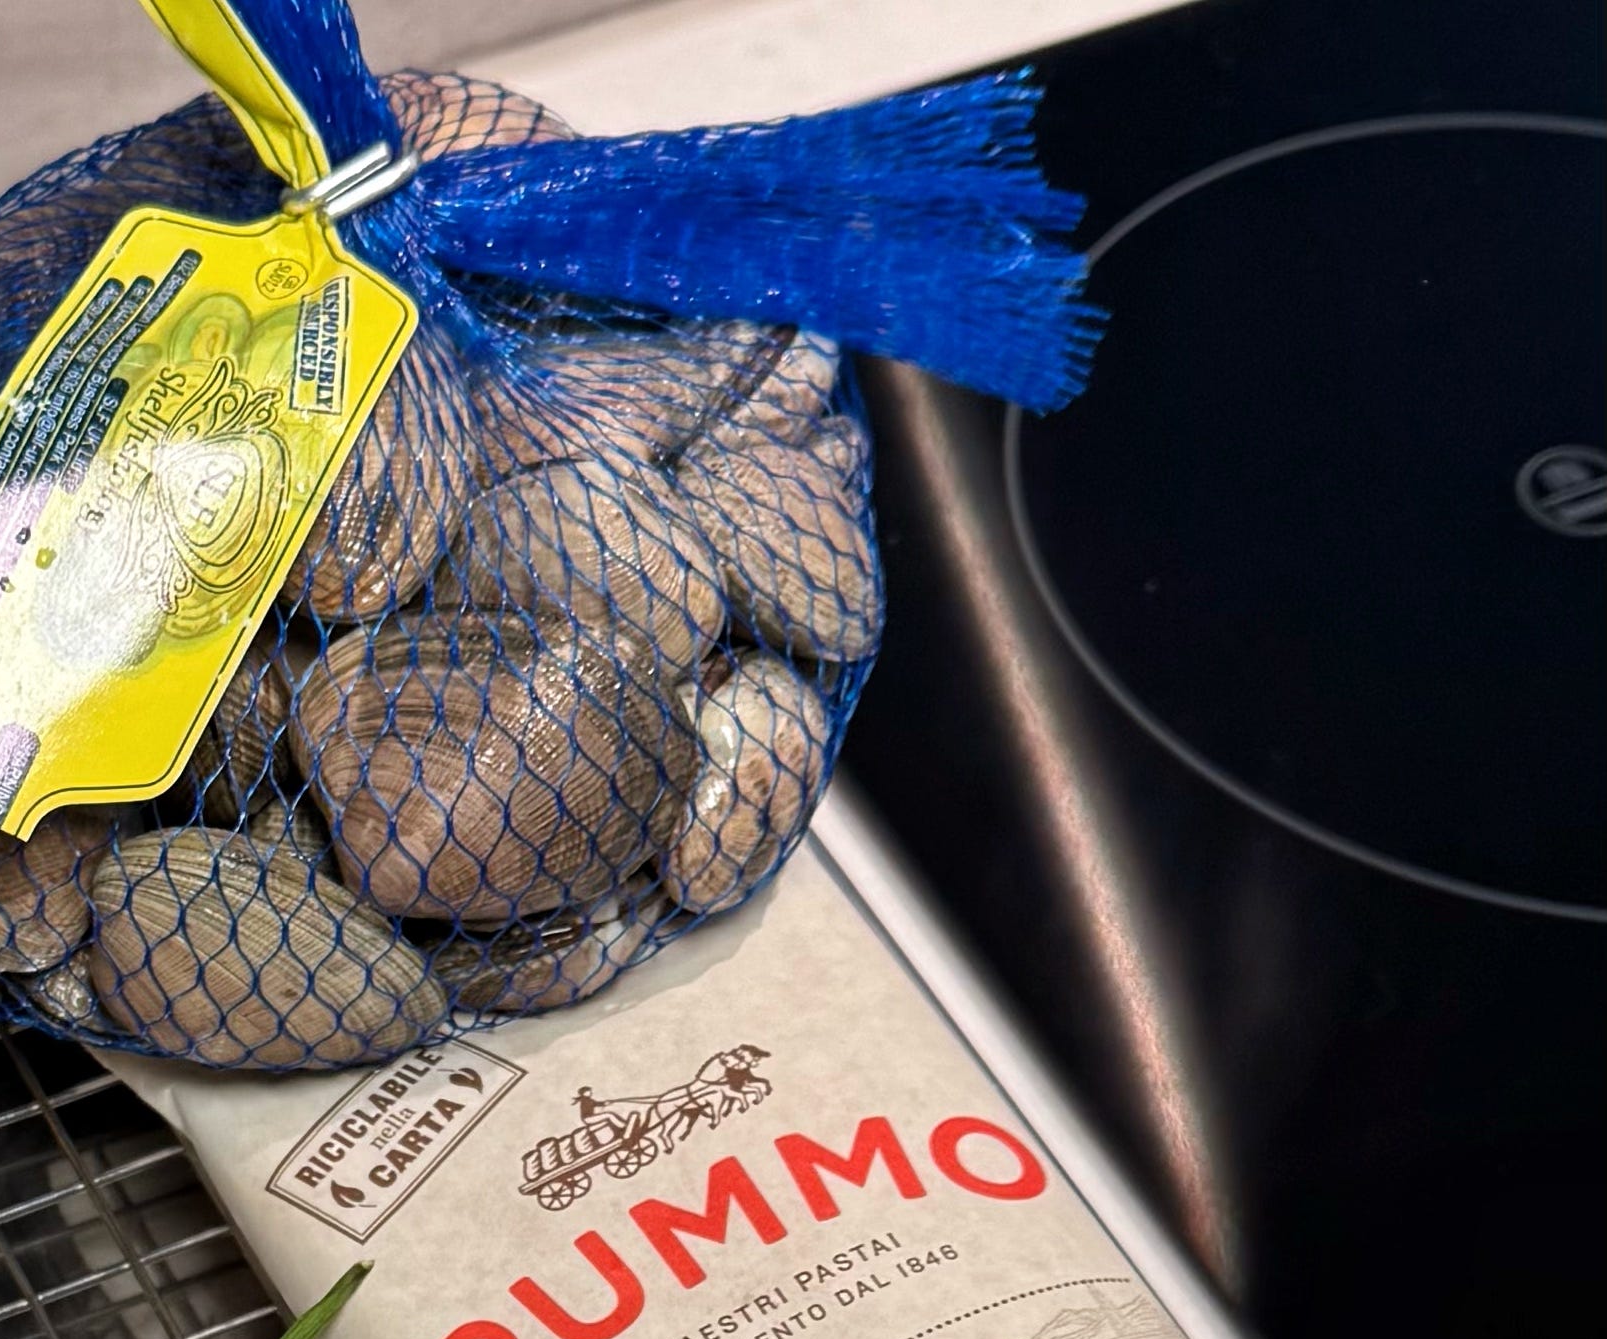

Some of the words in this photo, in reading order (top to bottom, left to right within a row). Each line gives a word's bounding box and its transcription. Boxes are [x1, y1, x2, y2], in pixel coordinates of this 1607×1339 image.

[315, 281, 340, 410] RESPONSIBLY
[65, 371, 107, 433] Business
[92, 393, 120, 427] SLF
[48, 429, 77, 467] Park
[80, 423, 105, 451] UK
[294, 1049, 445, 1188] RICICLABILE
[368, 1098, 466, 1188] CARTA
[369, 1106, 416, 1151] nella
[795, 1232, 903, 1292] PASTAI
[835, 1272, 892, 1308] DAL
[897, 1243, 960, 1280] 1846
